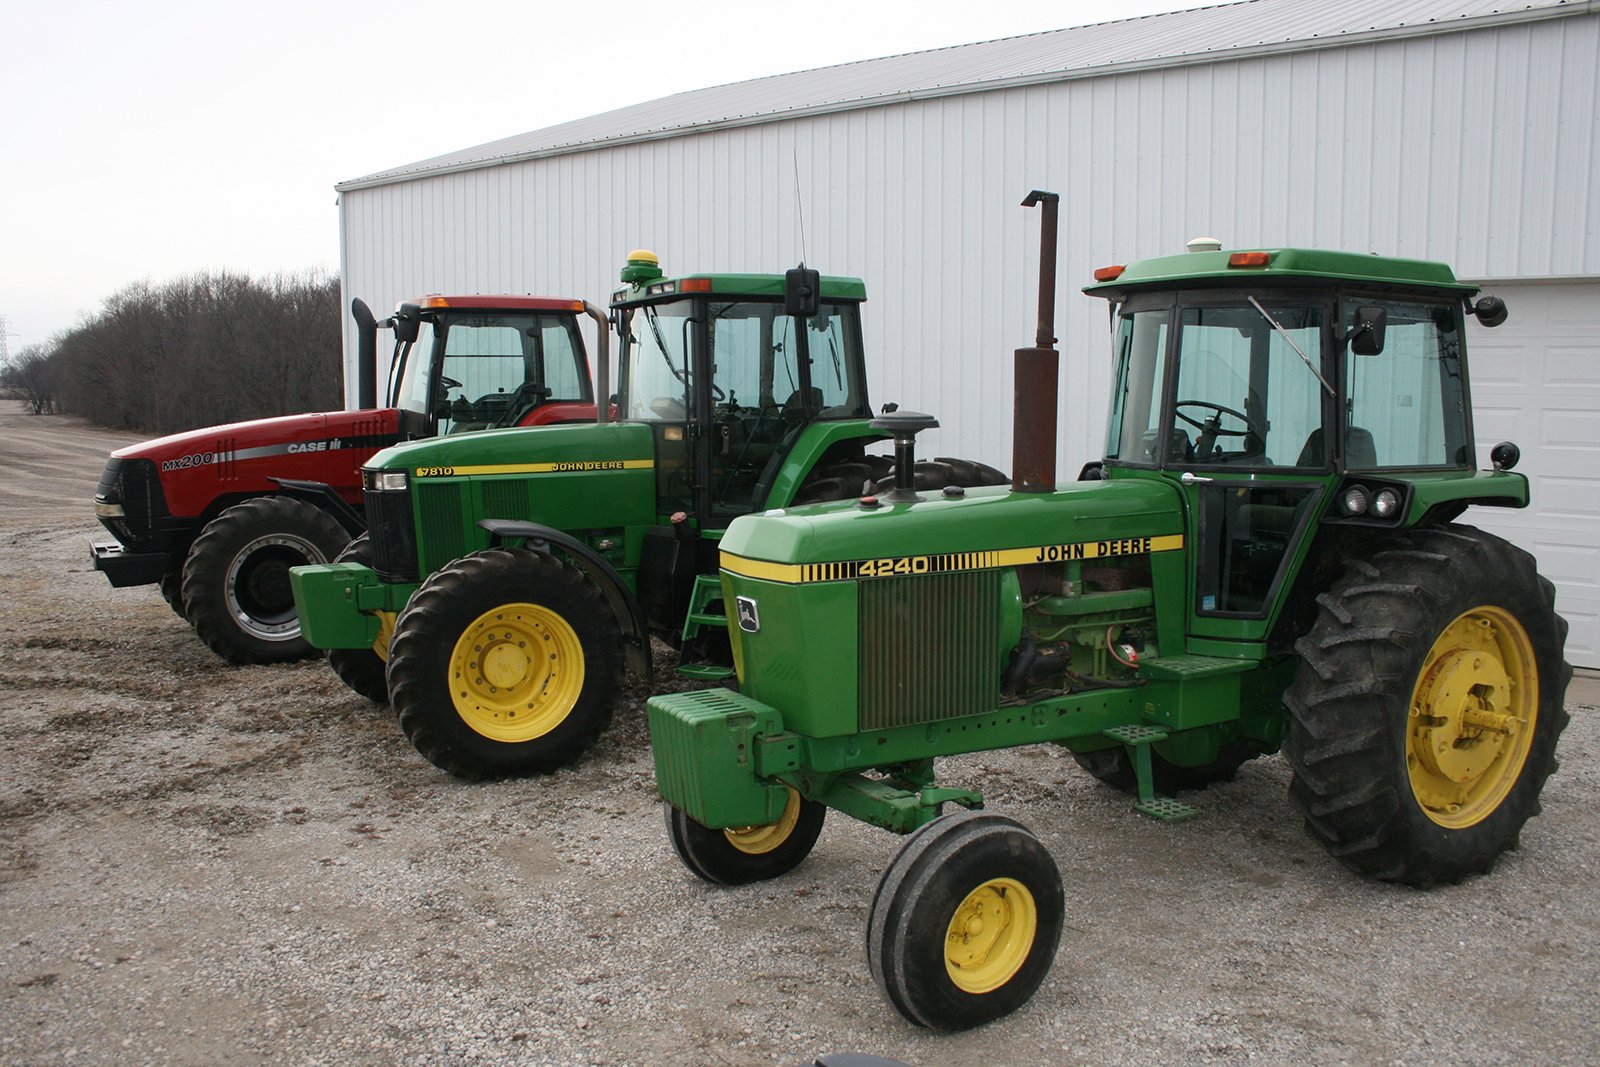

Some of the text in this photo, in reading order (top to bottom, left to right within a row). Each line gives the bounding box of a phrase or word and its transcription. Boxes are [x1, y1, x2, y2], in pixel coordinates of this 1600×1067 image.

[287, 442, 326, 453] CASE
[162, 453, 213, 471] MX200
[552, 461, 623, 472] JOHN DEERE
[422, 467, 453, 477] 7810
[1036, 538, 1151, 562] JOHN DEERE
[859, 556, 929, 577] 4240
